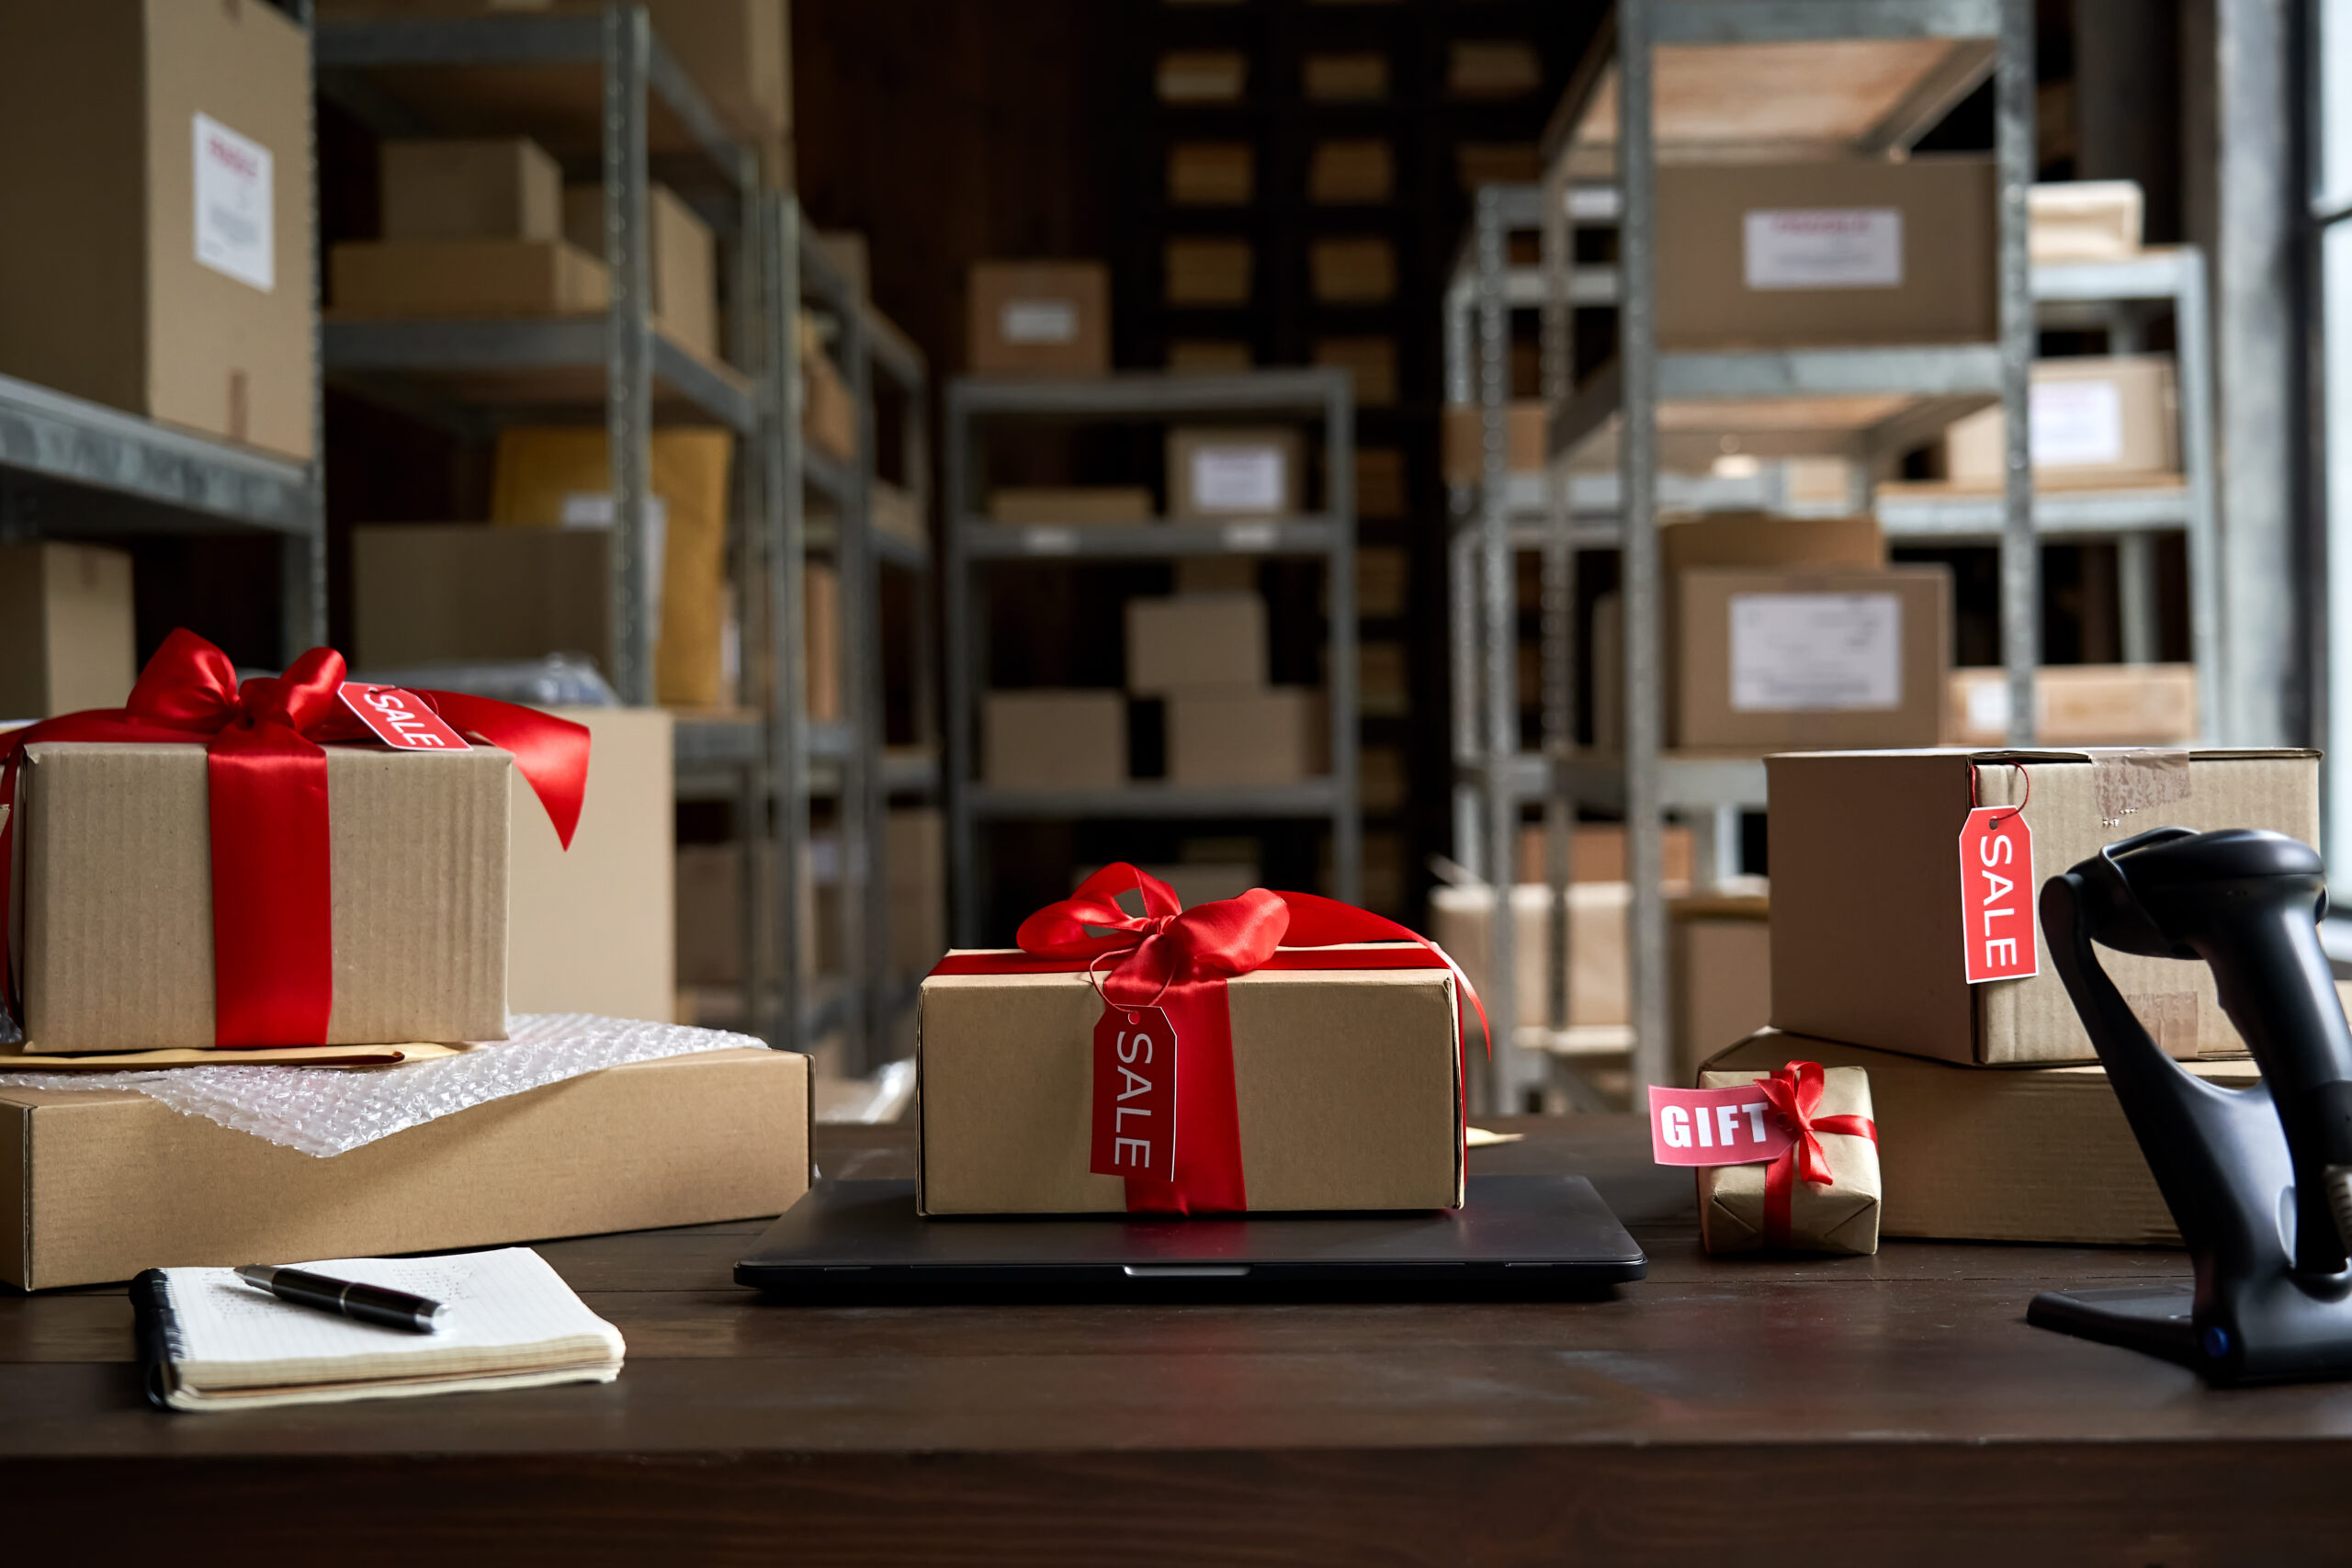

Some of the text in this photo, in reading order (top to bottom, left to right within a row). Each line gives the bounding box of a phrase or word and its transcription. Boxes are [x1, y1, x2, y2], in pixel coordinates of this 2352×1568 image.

[365, 692, 445, 747] SALE
[1980, 834, 2018, 968] SALE
[1114, 1031, 1153, 1168] SALE
[1660, 1102, 1770, 1148] GIFT
